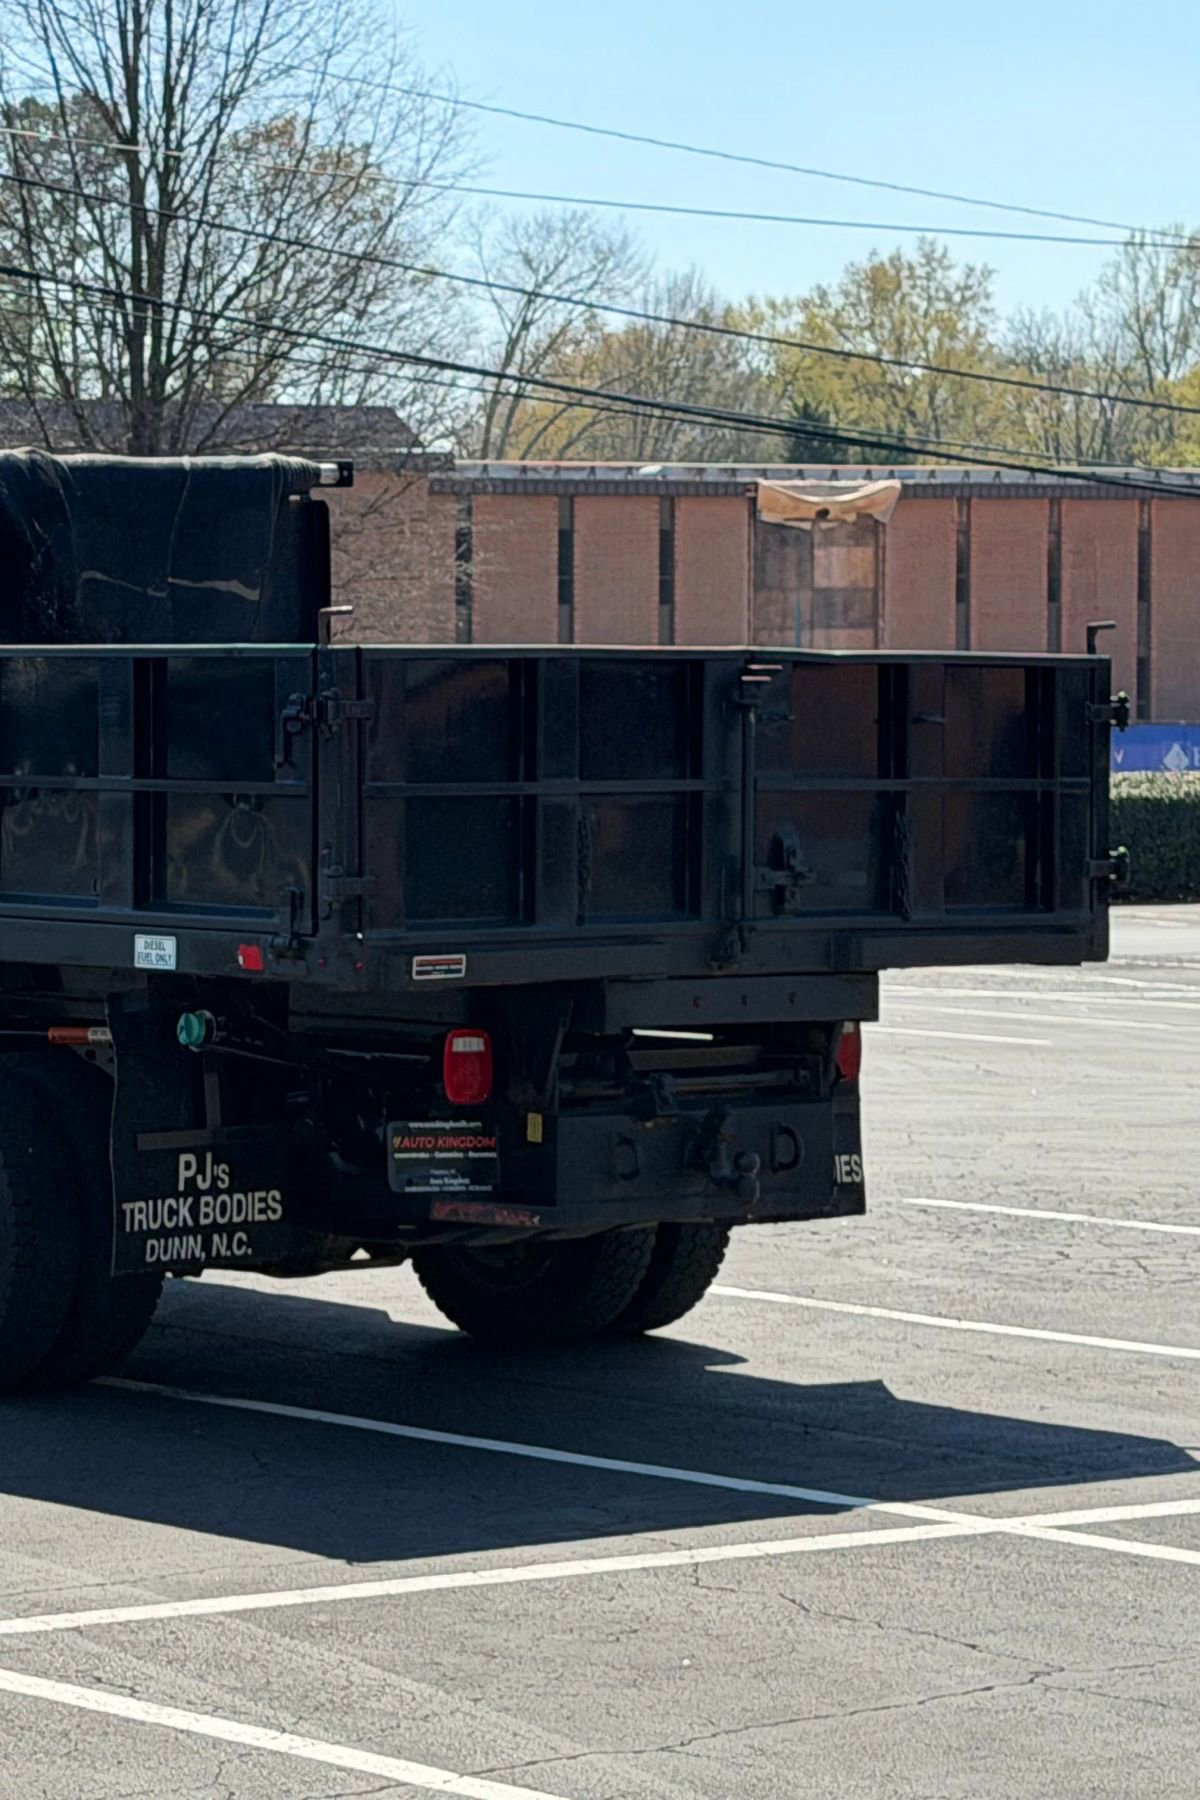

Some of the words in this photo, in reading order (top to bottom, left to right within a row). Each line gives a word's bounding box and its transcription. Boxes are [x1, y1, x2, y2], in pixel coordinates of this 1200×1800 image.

[144, 939, 166, 952] DIESEL
[137, 952, 154, 963] FUEL
[155, 953, 172, 965] ONLY
[400, 1136, 435, 1148] AUTO
[437, 1136, 497, 1148] KINGDOM
[833, 1153, 862, 1184] IES
[121, 1197, 194, 1232] TRUCK
[199, 1190, 283, 1225] BODIES
[145, 1235, 206, 1262] DUNN,
[212, 1232, 252, 1257] N.C.
